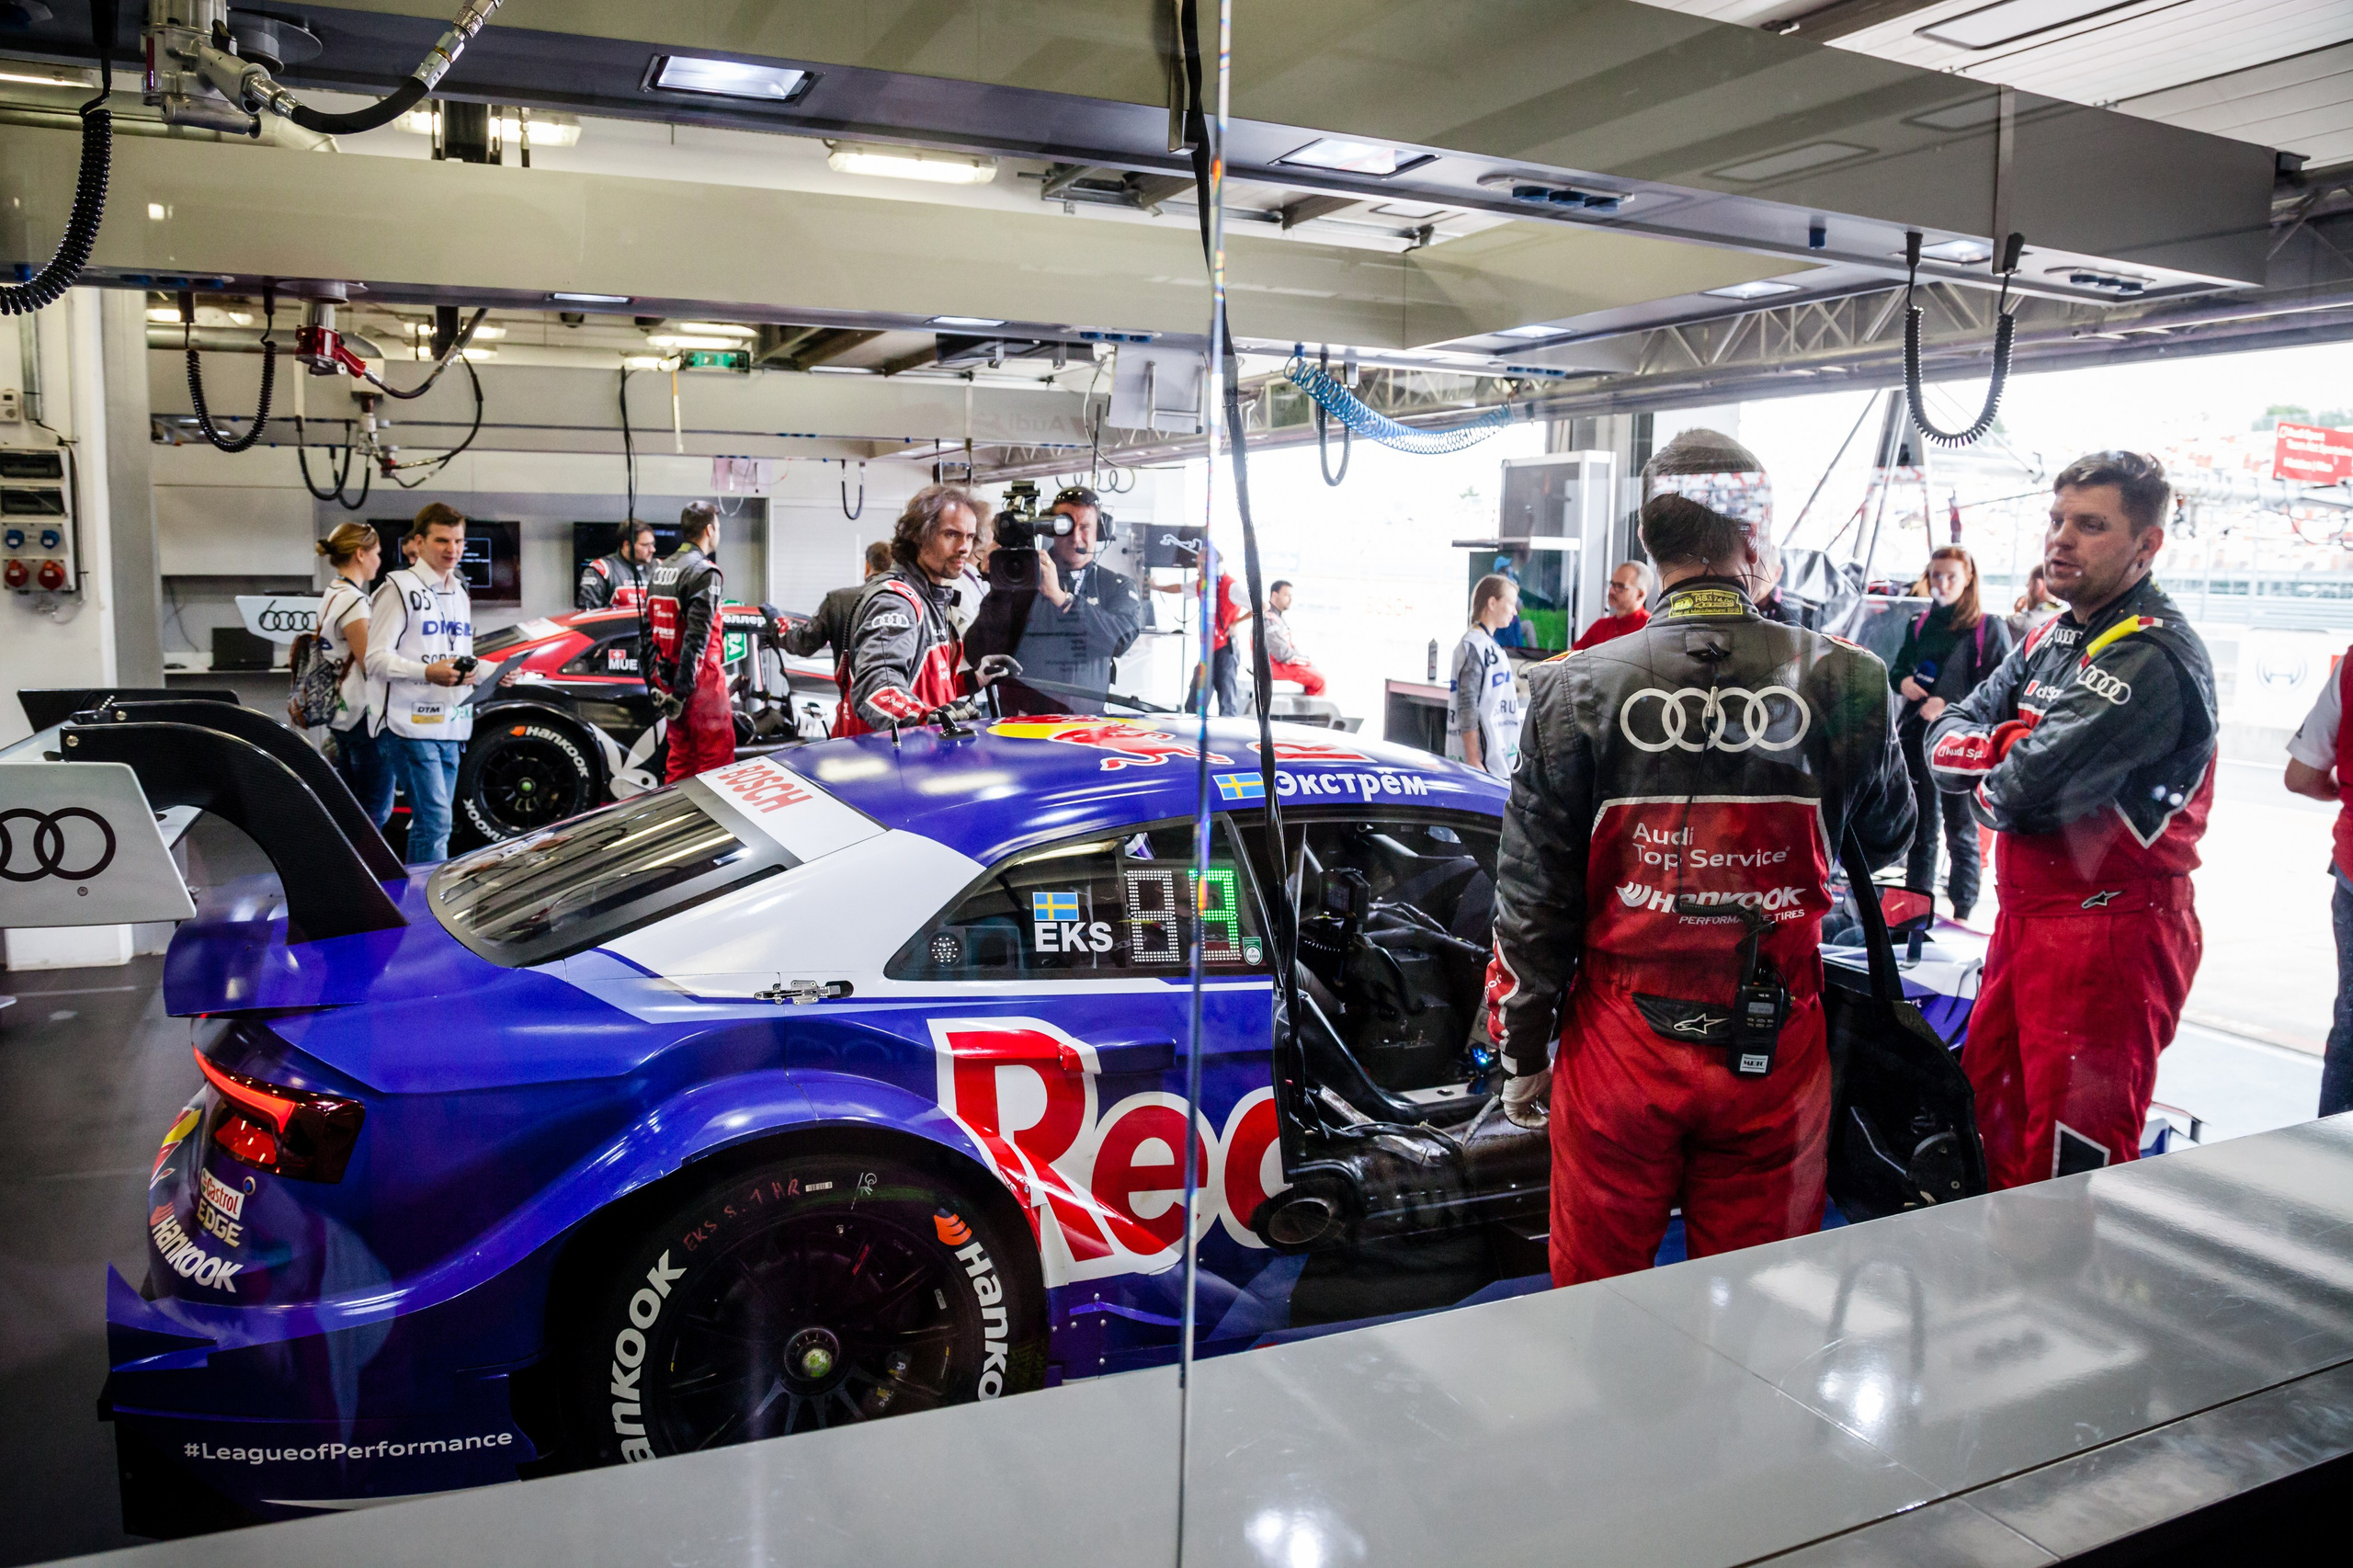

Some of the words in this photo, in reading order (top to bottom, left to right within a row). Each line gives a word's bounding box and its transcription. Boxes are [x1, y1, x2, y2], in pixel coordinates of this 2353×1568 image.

[608, 659, 639, 671] MUE
[417, 705, 440, 713] DTM
[717, 764, 813, 814] BOSCH
[1631, 822, 1695, 846] Audi
[1631, 842, 1683, 871] Top
[1689, 848, 1788, 869] Service
[1775, 908, 1805, 922] TIRES
[1034, 922, 1114, 953] EKS
[205, 1177, 239, 1215] Castrol
[196, 1198, 244, 1248] EDGE
[184, 1432, 513, 1466] #LeagueofPerformance
